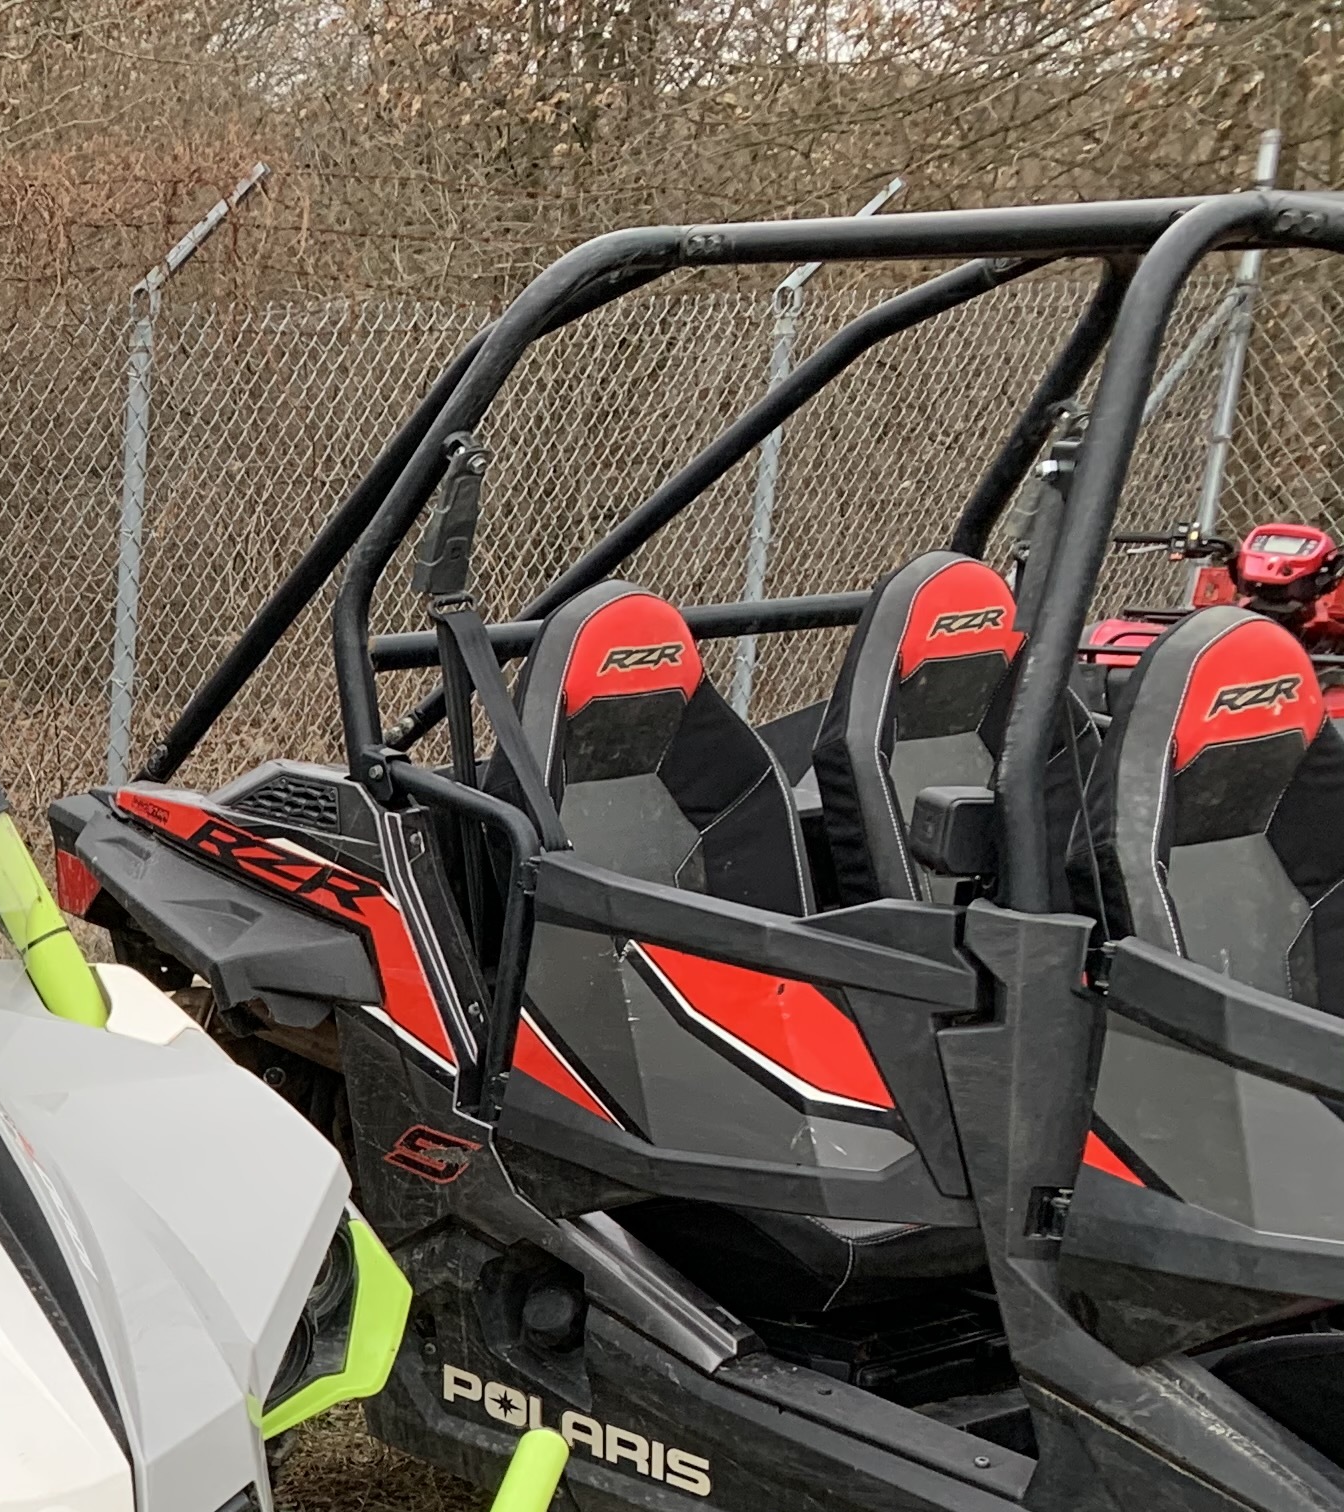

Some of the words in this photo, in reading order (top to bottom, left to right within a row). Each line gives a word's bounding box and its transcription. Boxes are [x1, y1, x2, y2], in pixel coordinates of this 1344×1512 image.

[926, 606, 1006, 642] RZR
[597, 642, 686, 677] RZR
[1204, 674, 1303, 721] RZR
[189, 820, 382, 917] RZR
